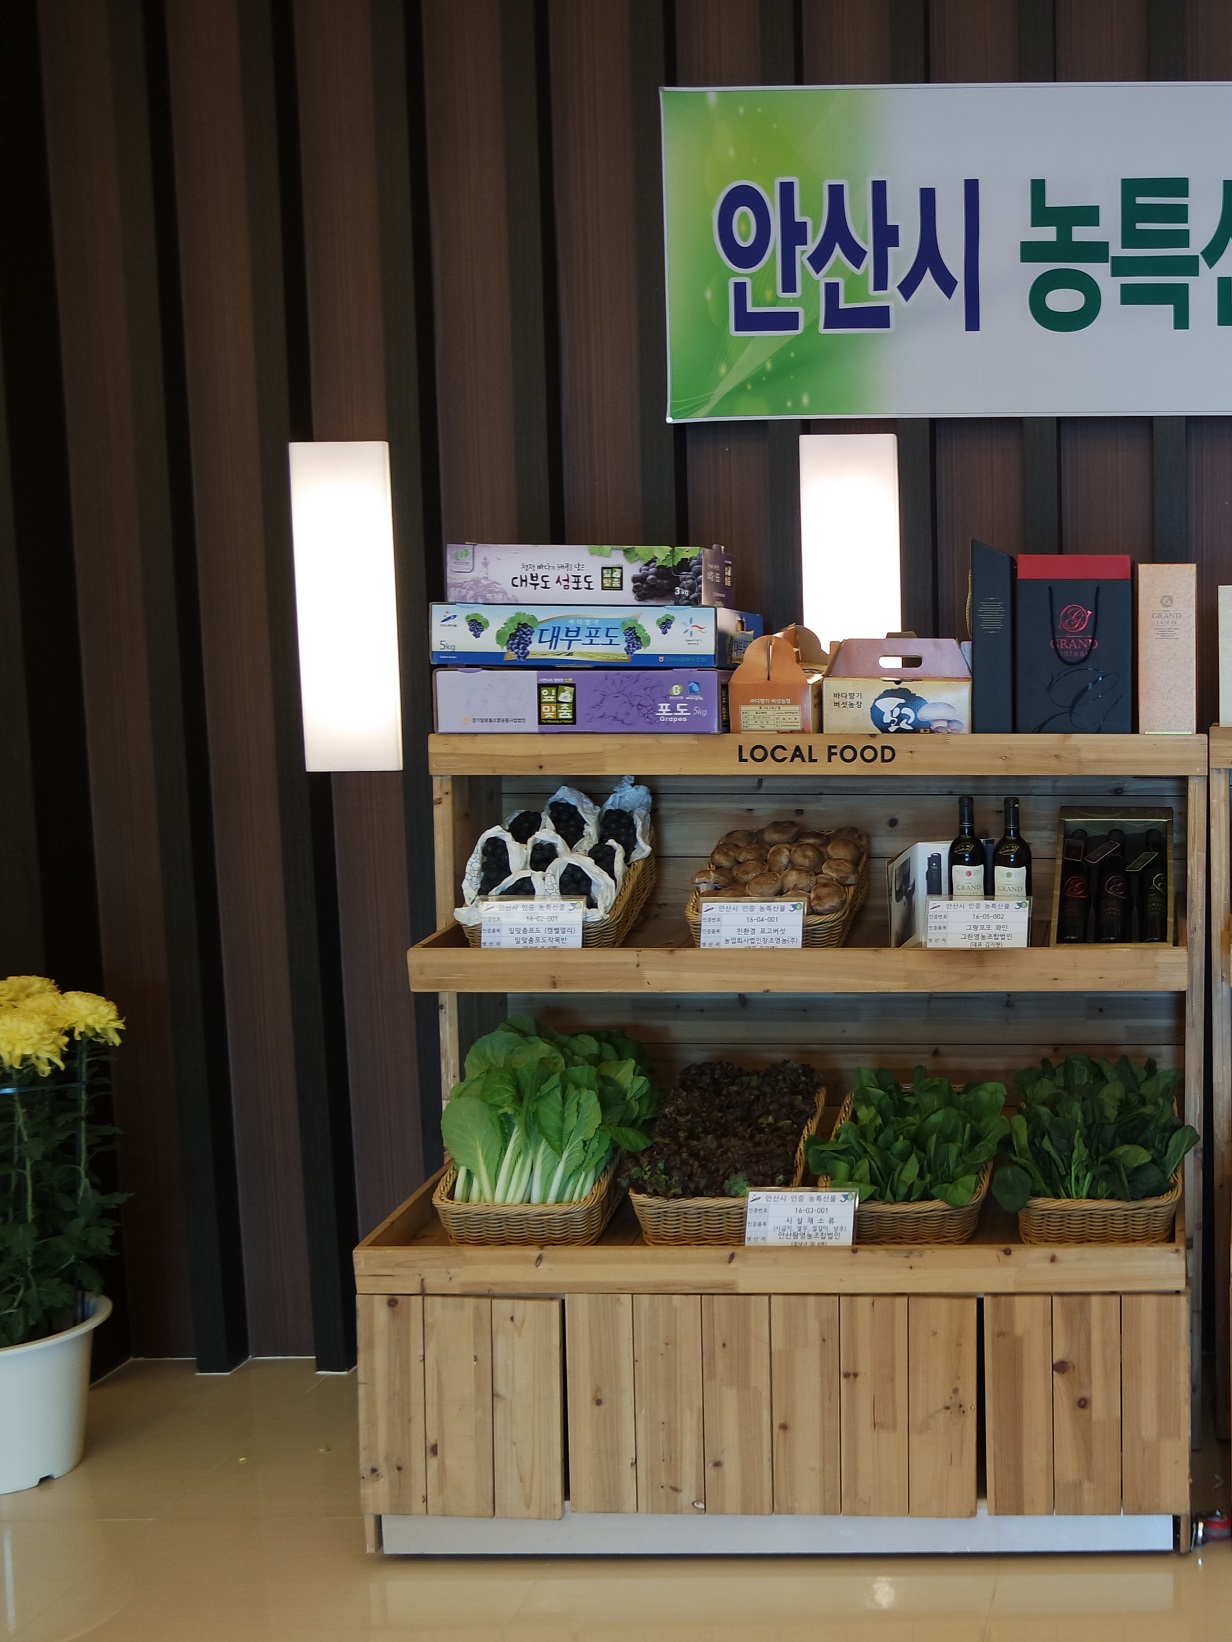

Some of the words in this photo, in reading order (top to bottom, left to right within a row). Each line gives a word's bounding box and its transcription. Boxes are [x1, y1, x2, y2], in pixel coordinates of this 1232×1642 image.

[717, 178, 980, 332] 안산시
[511, 572, 551, 590] 대부도
[439, 641, 456, 652] 5kg
[538, 625, 621, 651] 대부포도
[656, 703, 691, 716] 포도
[738, 744, 818, 763] LOCAL
[827, 744, 896, 763] FOOD
